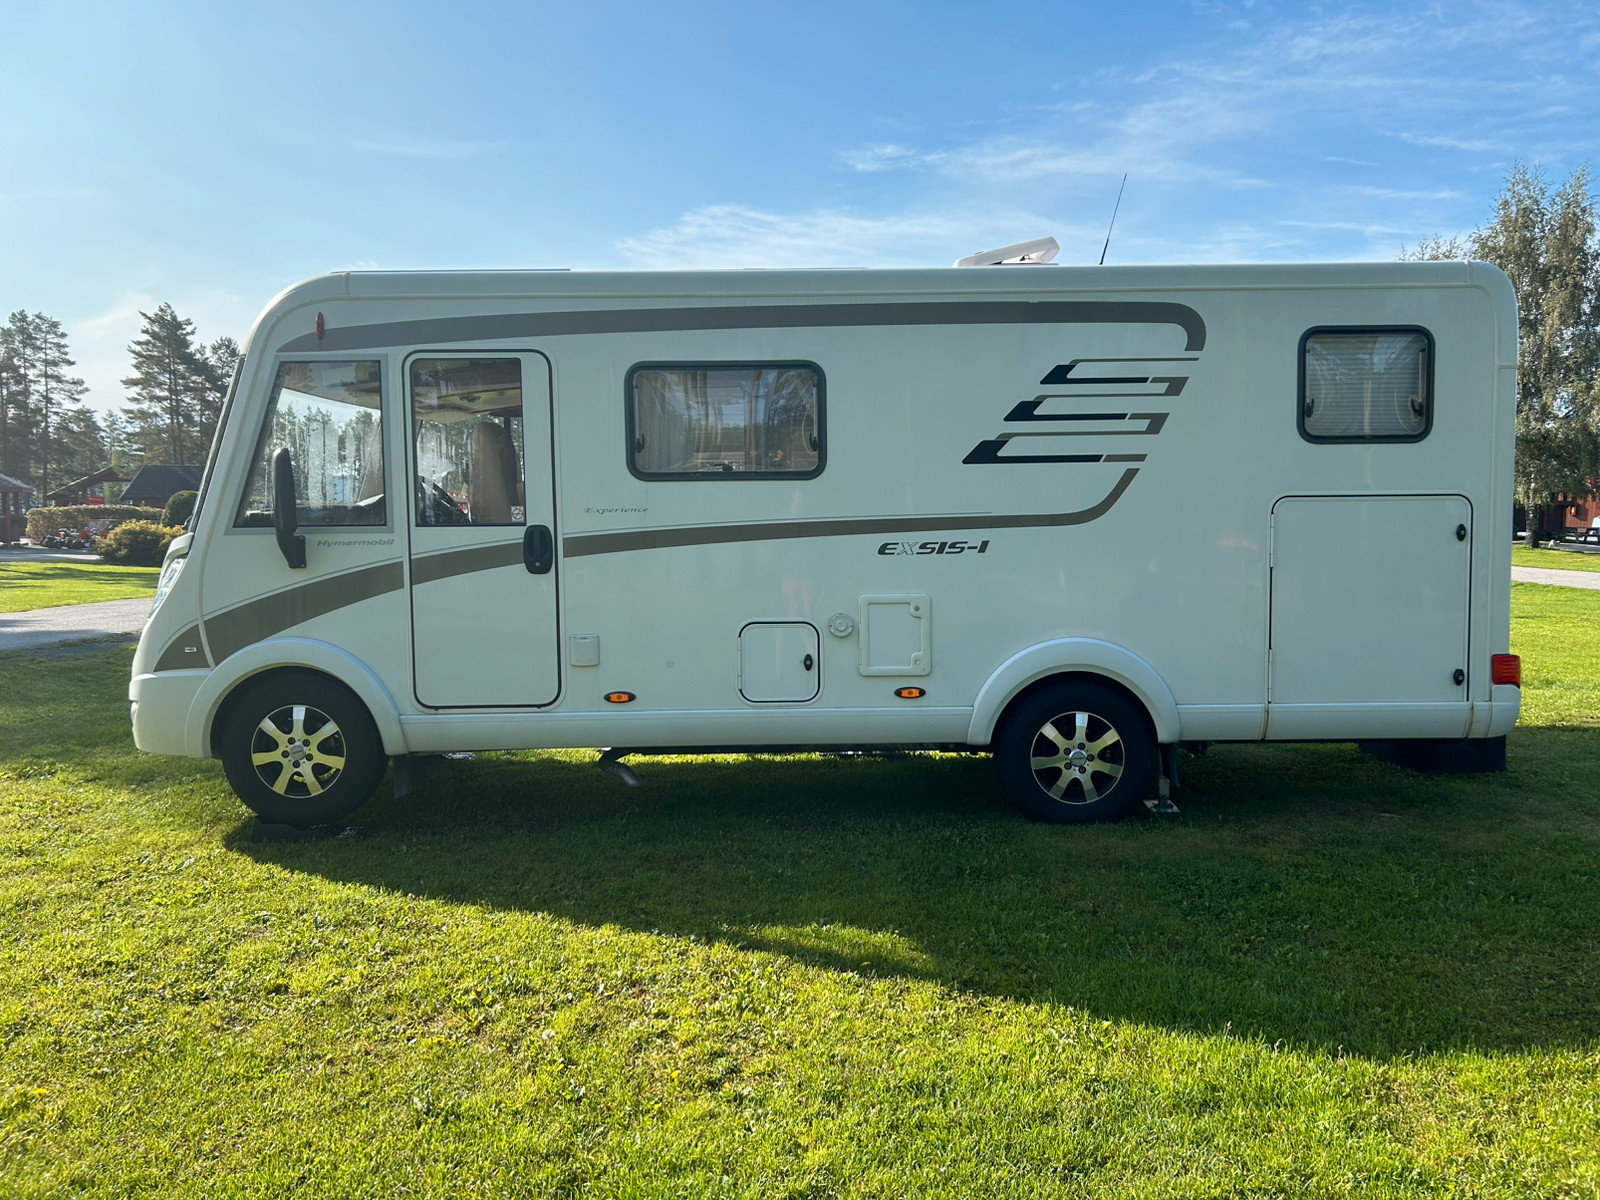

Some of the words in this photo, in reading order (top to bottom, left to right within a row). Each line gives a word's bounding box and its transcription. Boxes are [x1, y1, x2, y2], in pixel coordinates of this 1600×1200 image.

[583, 507, 649, 515] Experience
[316, 538, 394, 548] Hymermobil
[878, 540, 990, 555] EXSIS-I
